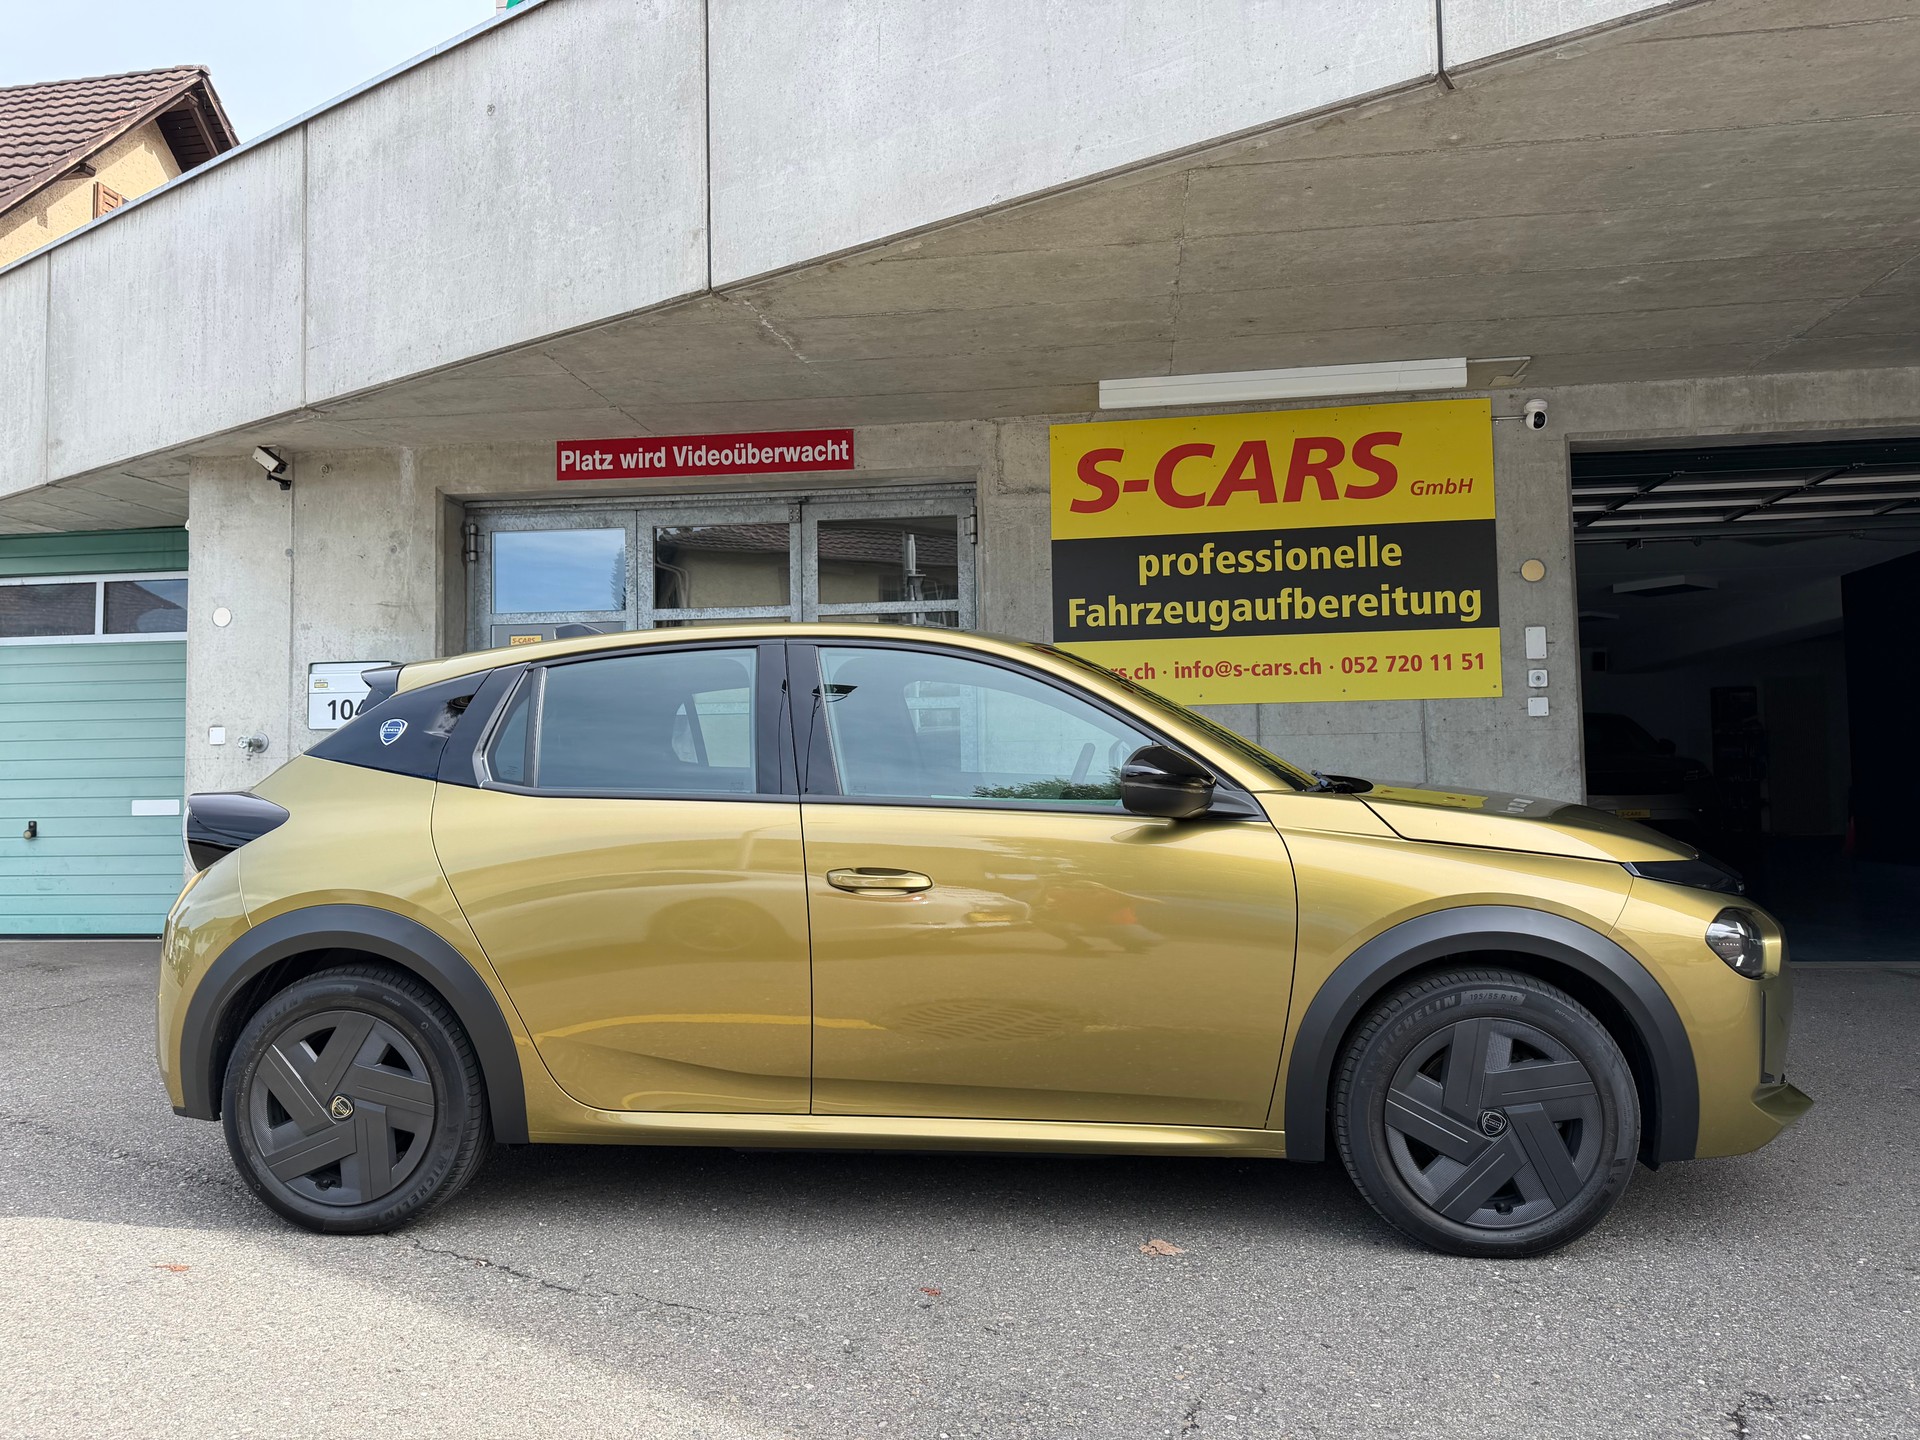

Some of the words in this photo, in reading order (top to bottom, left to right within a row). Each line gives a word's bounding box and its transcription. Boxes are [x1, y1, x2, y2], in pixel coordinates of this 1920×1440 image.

[560, 450, 613, 472] Platz
[620, 447, 666, 469] wird
[673, 440, 849, 467] Videoüberwacht
[1070, 431, 1403, 514] S-CARS
[1410, 477, 1474, 497] GmbH
[1138, 534, 1403, 586] professionelle
[1068, 583, 1482, 632] Fahrzeugaufbereitung
[1174, 656, 1322, 680] info@s-cars.ch
[1341, 656, 1378, 675] 052
[1386, 654, 1423, 673] 720
[1431, 653, 1453, 671] 11
[1462, 652, 1485, 671] 51
[1377, 994, 1457, 1058] MICHELIN
[1469, 992, 1498, 1001] 195/55
